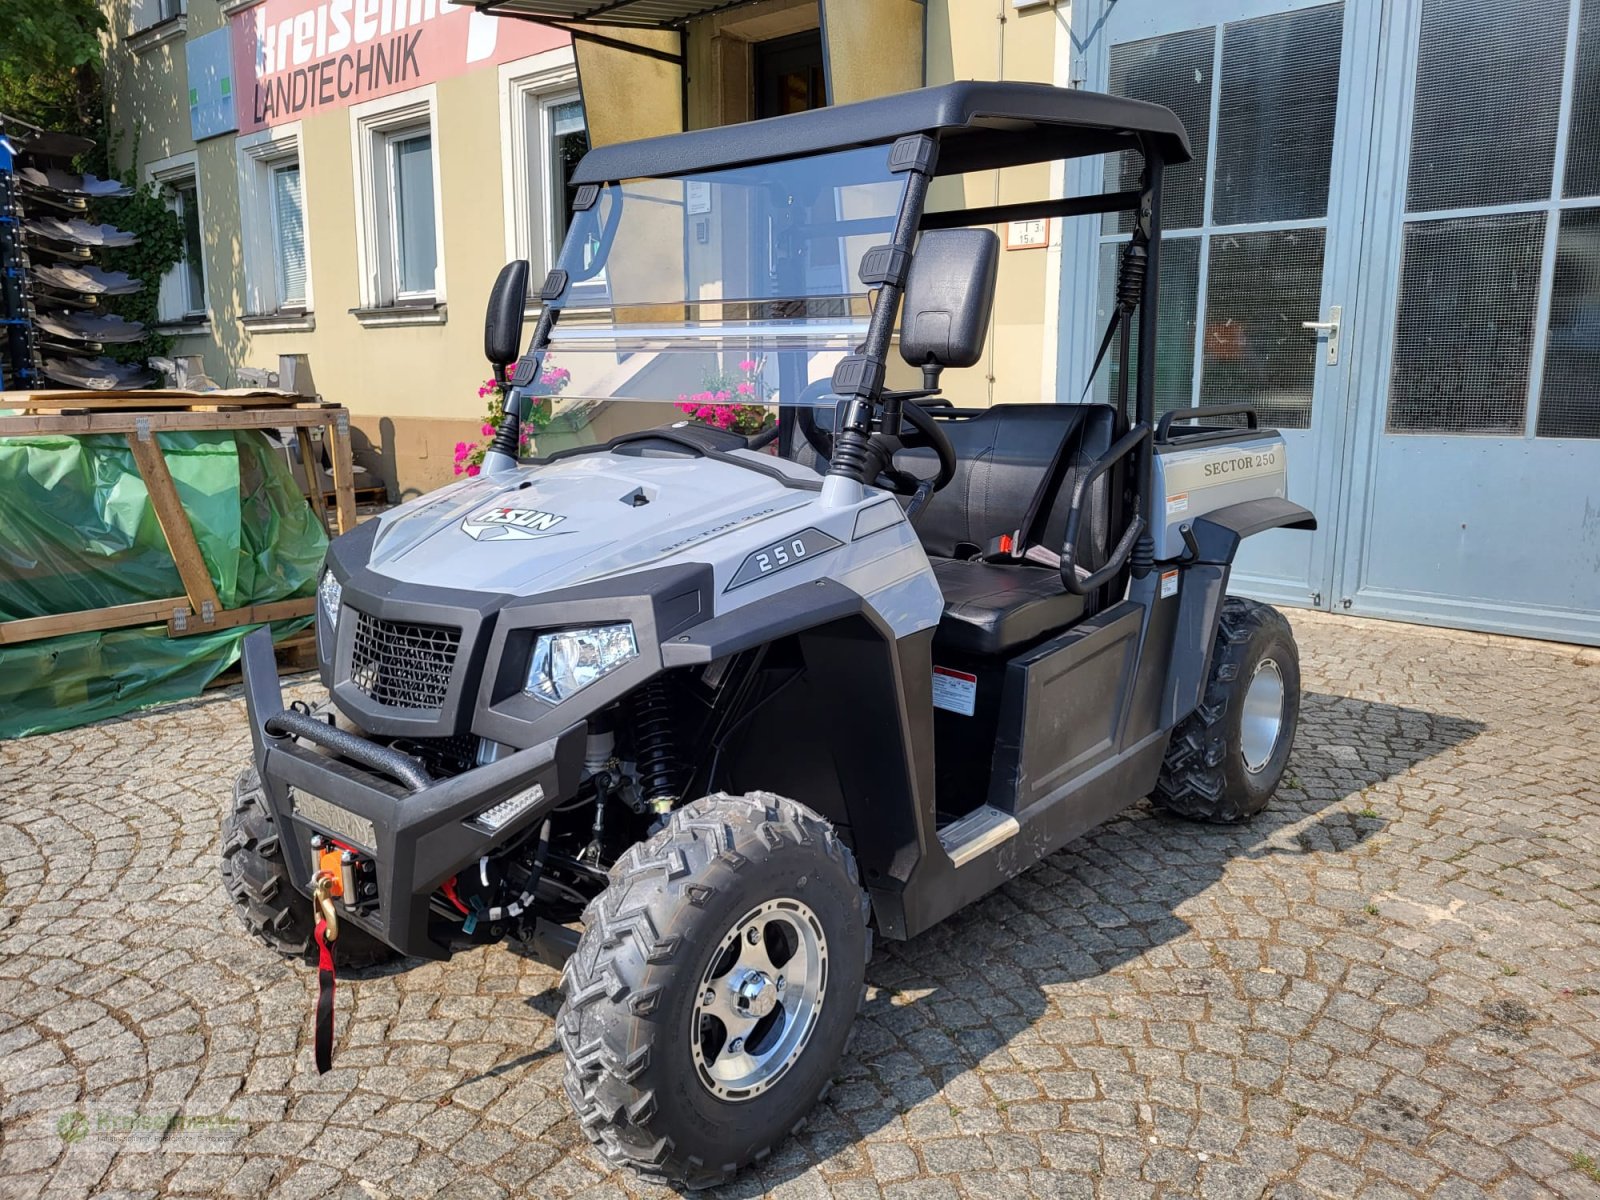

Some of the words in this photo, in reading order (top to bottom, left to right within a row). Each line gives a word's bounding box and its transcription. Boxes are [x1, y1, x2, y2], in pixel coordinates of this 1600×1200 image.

[253, 29, 424, 124] LANDTECHNIK
[1204, 456, 1253, 477] SECTOR
[1255, 452, 1275, 467] 250
[659, 520, 738, 552] SECTOR
[741, 508, 774, 521] 250
[756, 539, 806, 573] 250
